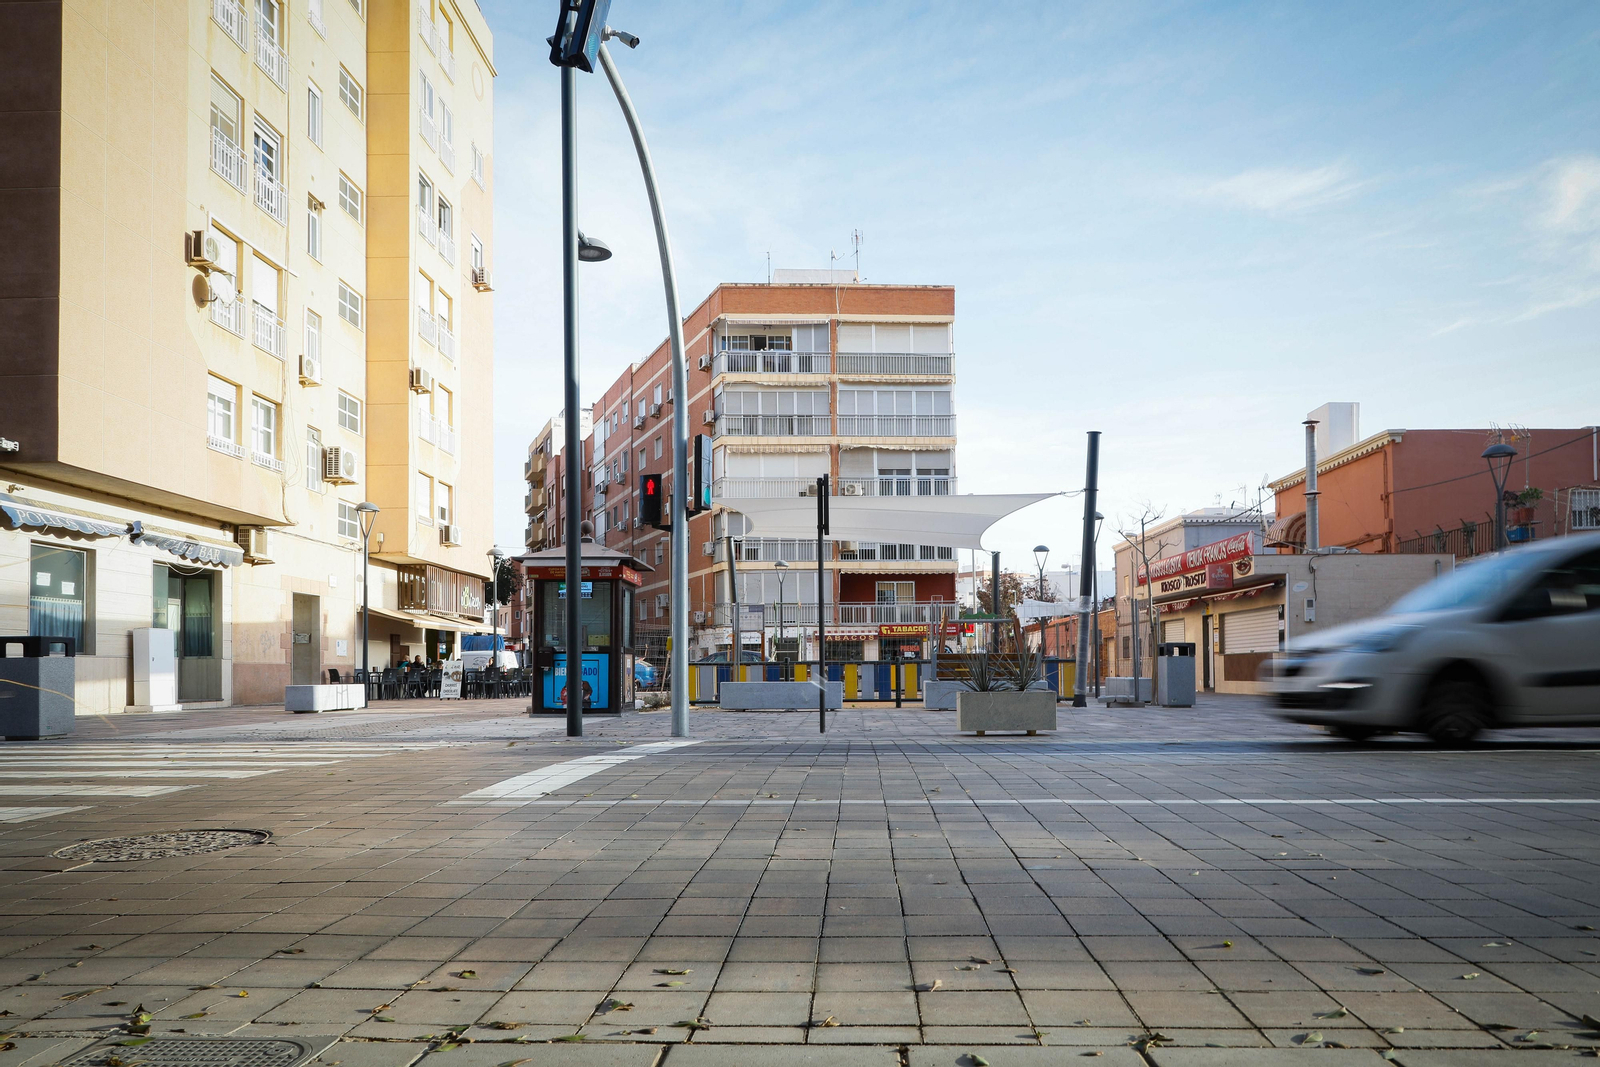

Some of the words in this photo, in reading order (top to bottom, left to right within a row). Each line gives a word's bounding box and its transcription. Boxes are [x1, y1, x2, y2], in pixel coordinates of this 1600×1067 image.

[14, 509, 79, 529] POLLOS
[199, 545, 221, 560] BAR
[1203, 541, 1227, 565] FRANCIS
